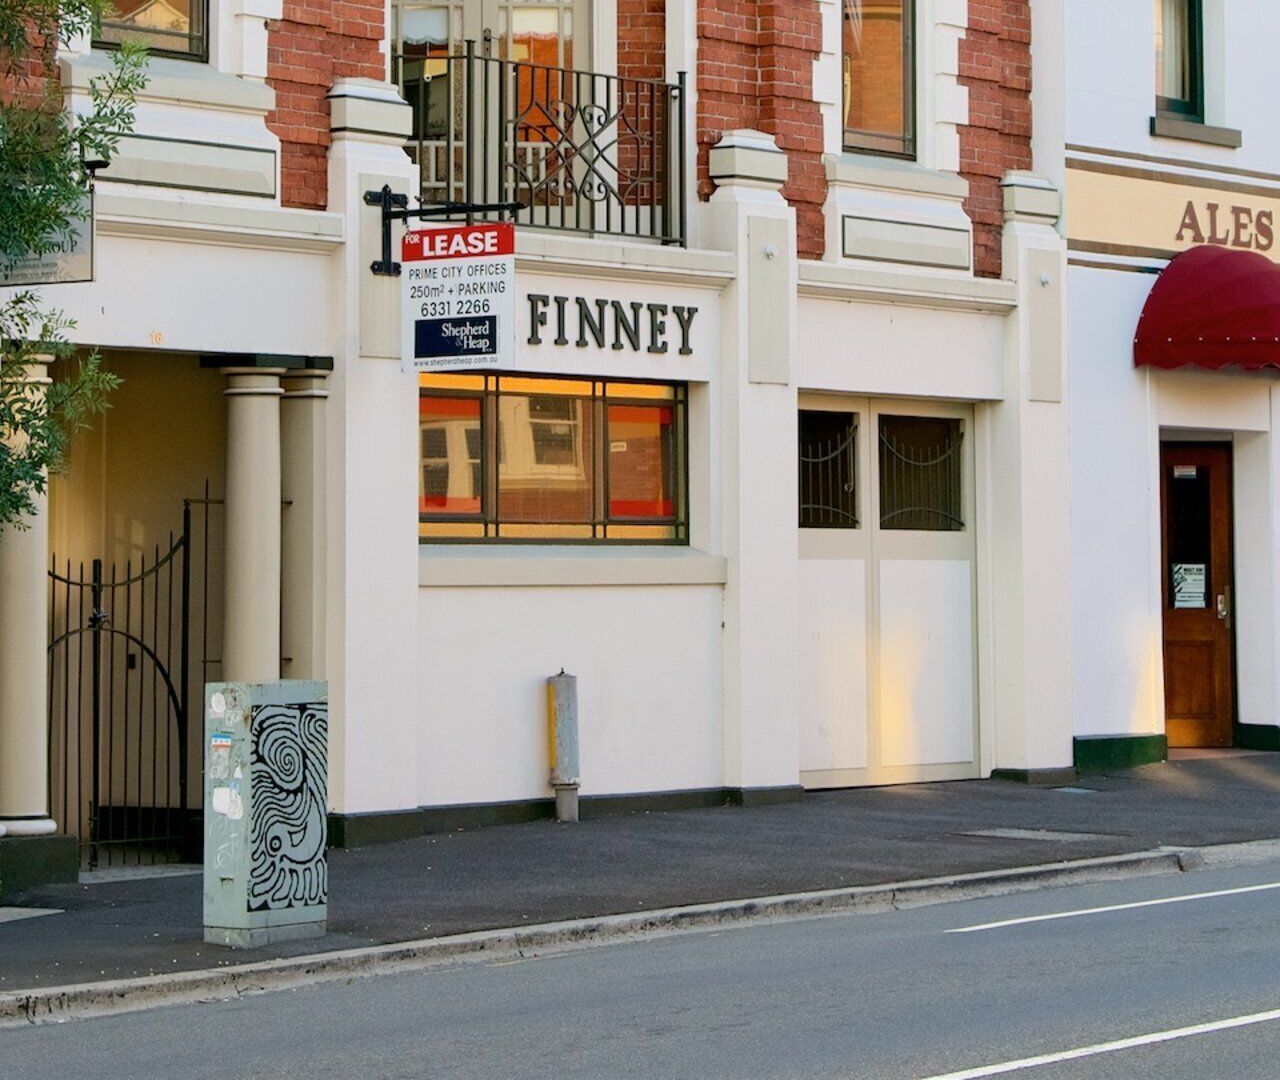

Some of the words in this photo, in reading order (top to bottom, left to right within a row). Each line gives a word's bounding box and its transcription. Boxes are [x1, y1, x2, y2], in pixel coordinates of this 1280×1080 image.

[1175, 200, 1274, 251] ALES
[405, 234, 420, 245] FOR
[423, 231, 498, 257] LEASE
[409, 267, 438, 280] PRIME
[441, 266, 463, 278] CITY
[467, 263, 507, 277] OFFICES
[458, 281, 505, 296] PARKING
[421, 301, 451, 317] 6331
[457, 299, 490, 315] 2266
[441, 320, 489, 340] Shepherd
[527, 293, 699, 355] FINNEY
